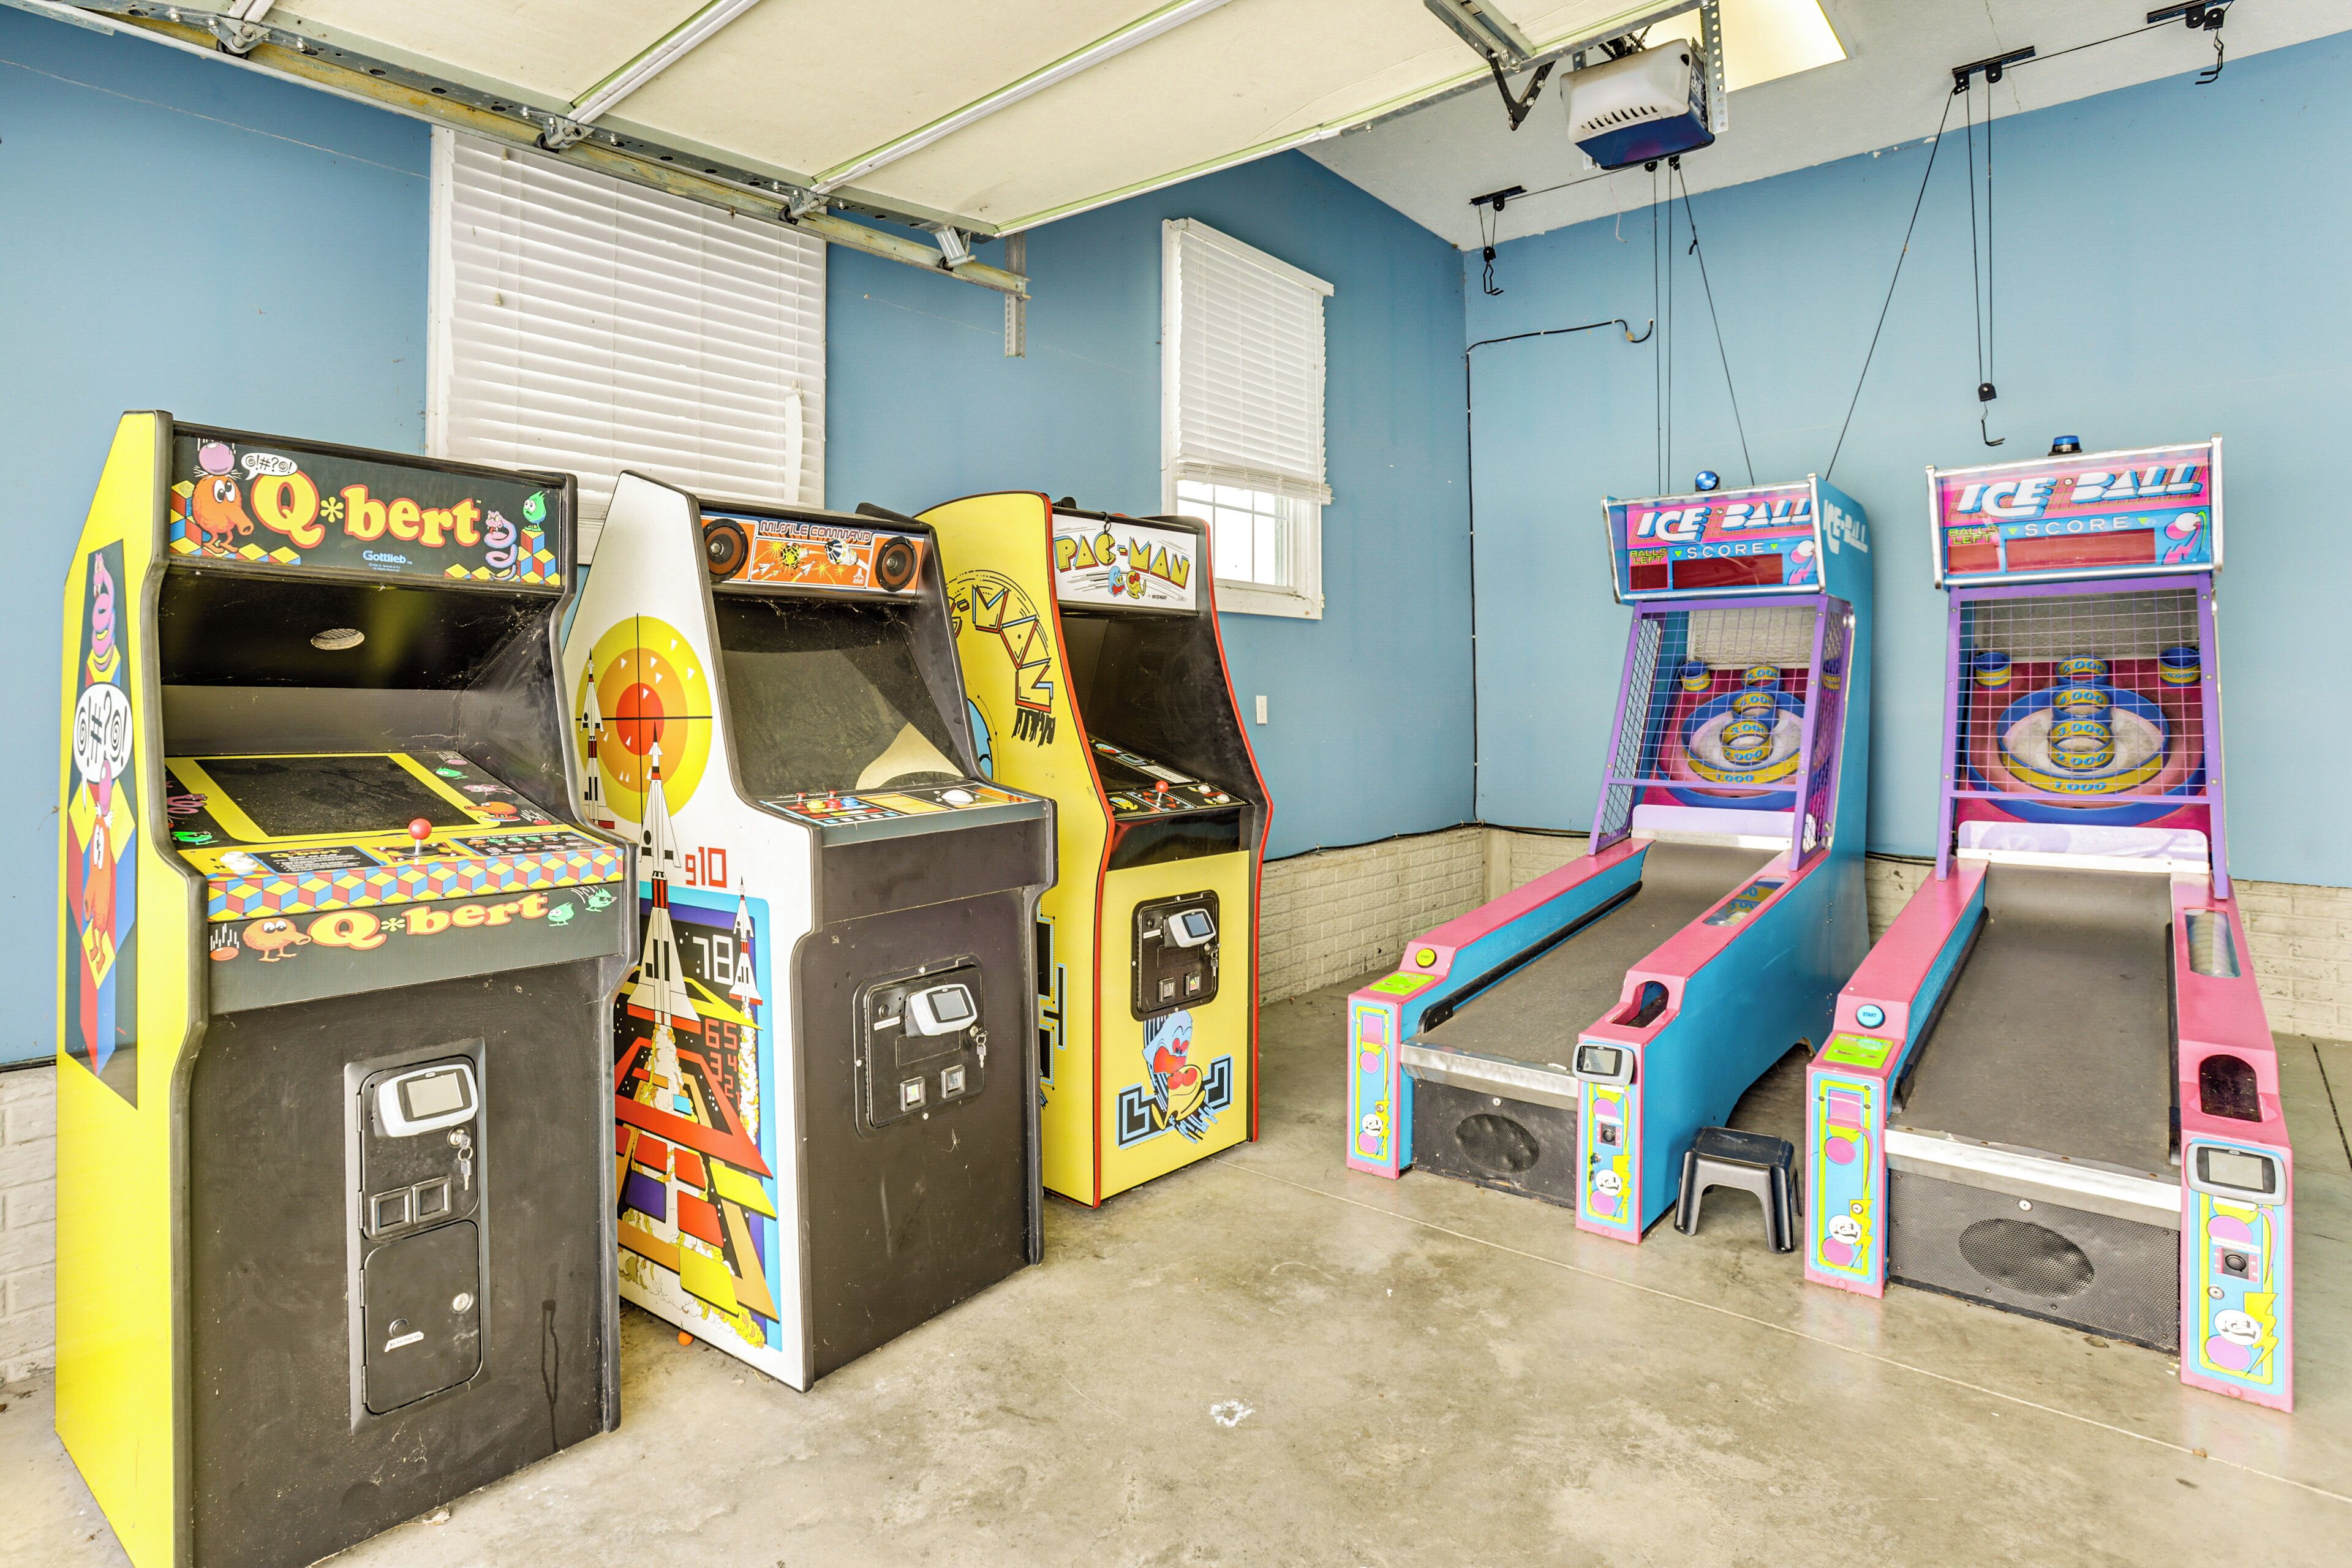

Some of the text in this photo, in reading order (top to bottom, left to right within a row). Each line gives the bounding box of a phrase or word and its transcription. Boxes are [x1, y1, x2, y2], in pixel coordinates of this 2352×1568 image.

[1957, 461, 2203, 519] ICE BALL
[1637, 497, 1811, 543] ICE BALL
[2024, 516, 2130, 537] SCORE
[760, 520, 873, 543] MISSILE COMMAND
[1948, 525, 1999, 537] BALLS
[1953, 533, 1992, 545] LEFT
[363, 550, 407, 564] Gottlieb
[1630, 548, 1668, 557] BALLS
[1686, 543, 1765, 560] SCORE
[1054, 531, 1190, 590] PAC-MAN
[1634, 556, 1663, 564] LEFT
[2058, 723, 2105, 737] 3,000
[2056, 752, 2106, 766] 2,000
[2054, 780, 2106, 791] 1,000
